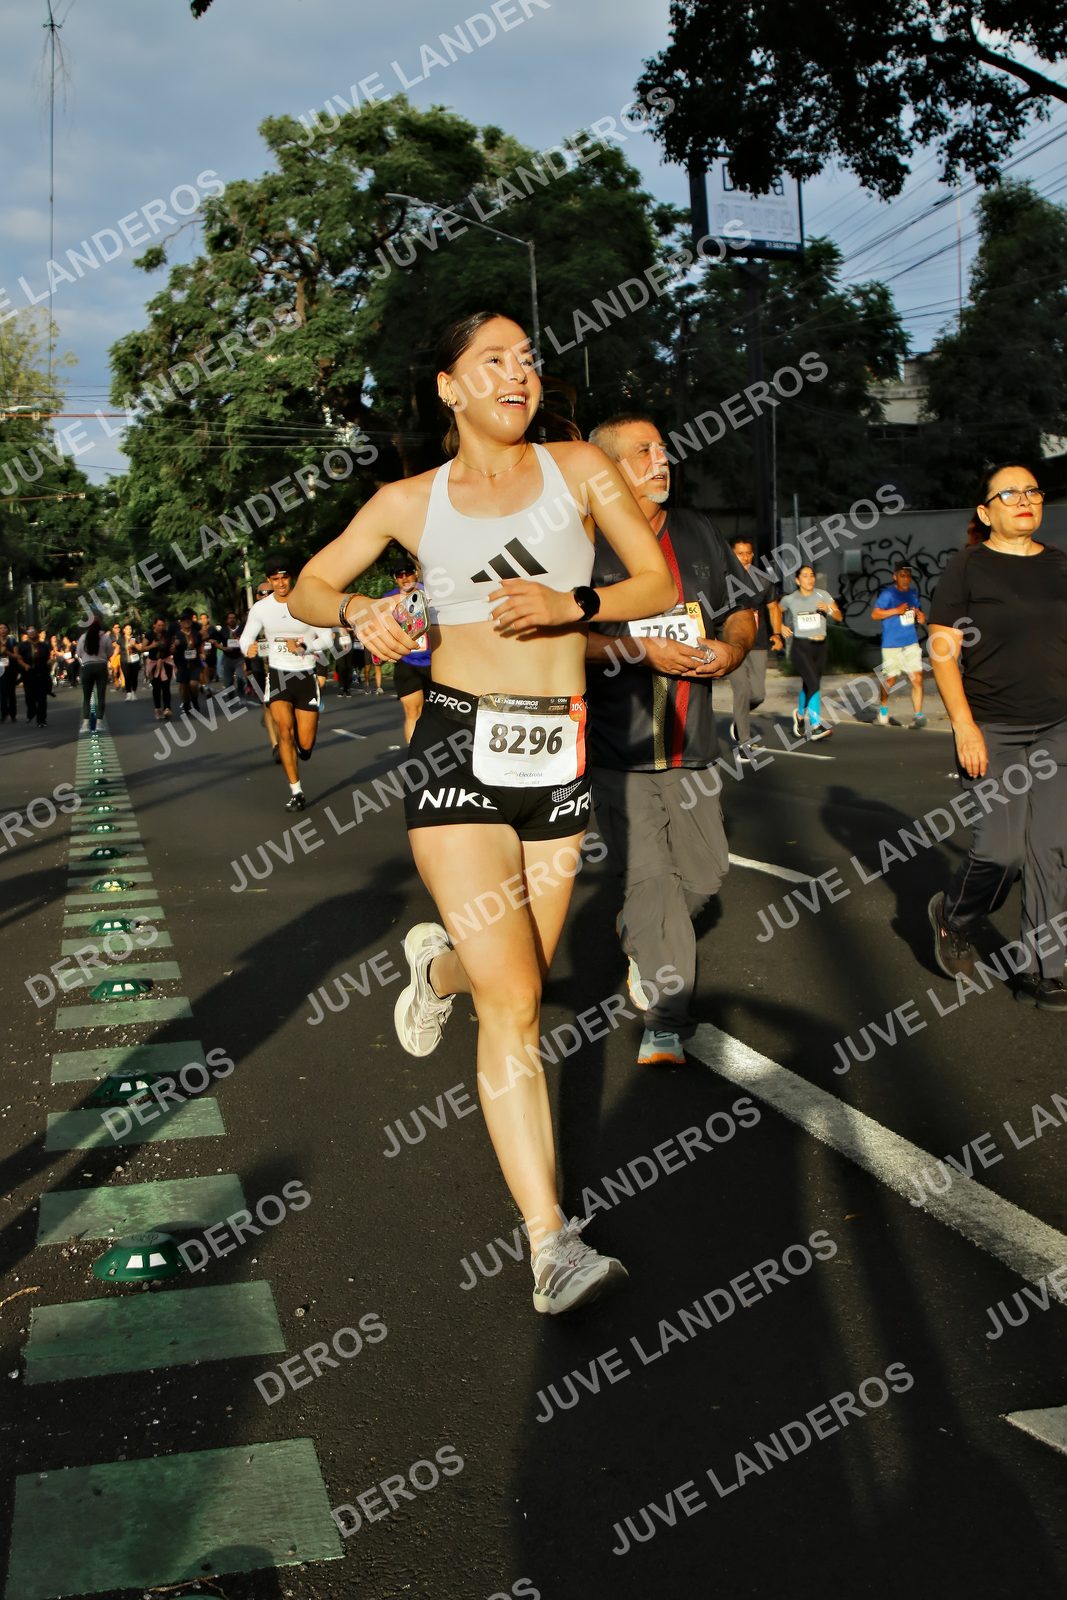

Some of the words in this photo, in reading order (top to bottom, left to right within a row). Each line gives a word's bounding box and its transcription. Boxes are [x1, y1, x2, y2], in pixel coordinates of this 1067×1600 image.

[862, 534, 913, 553] TOY
[640, 622, 689, 642] 7765
[572, 703, 582, 711] 10K
[488, 723, 563, 756] 8296
[549, 786, 592, 822] PR
